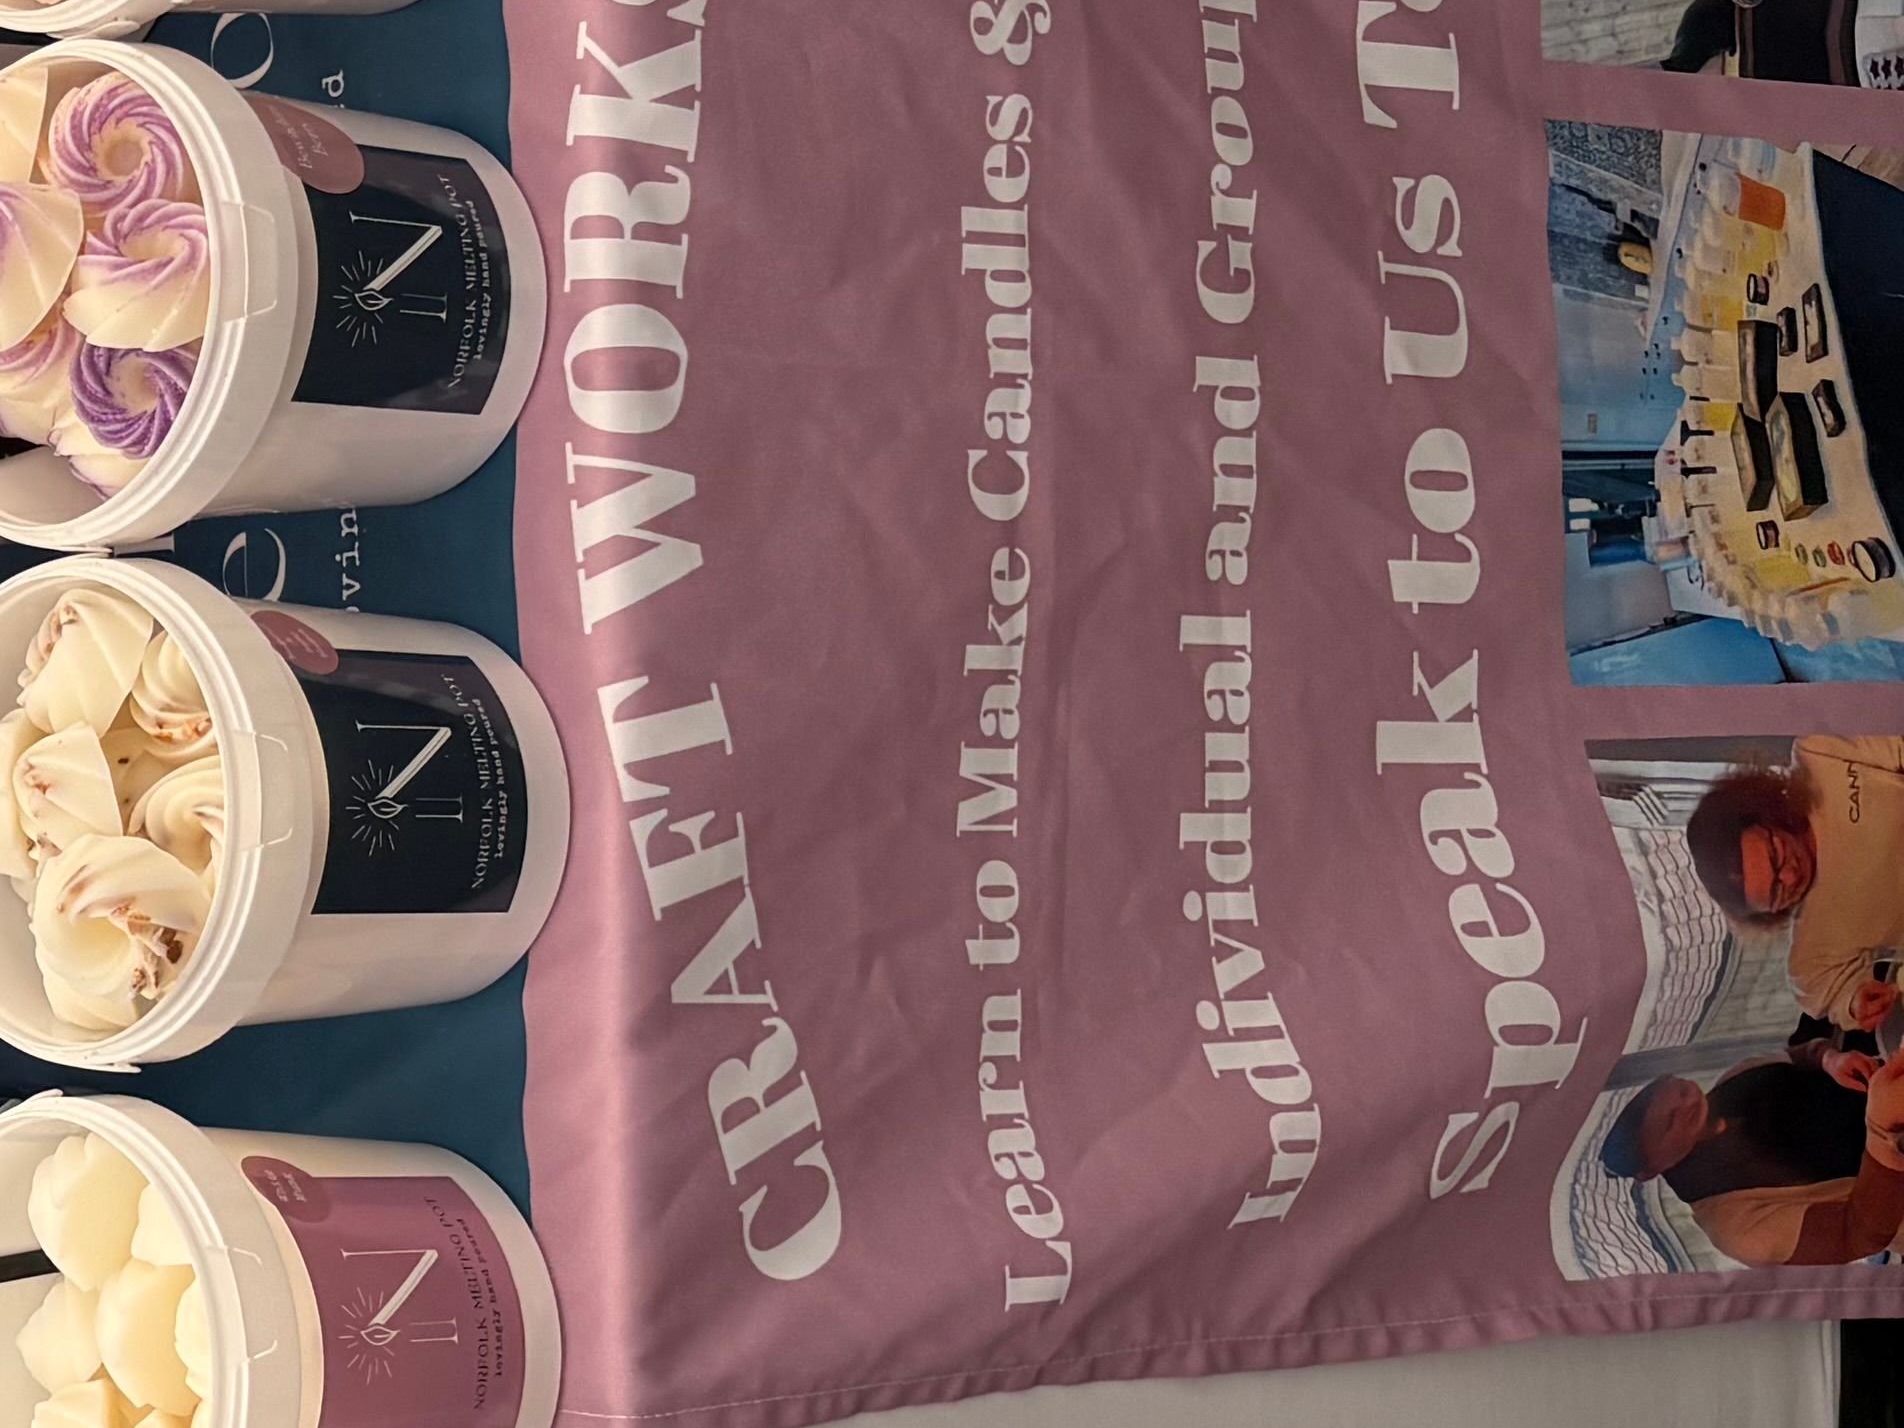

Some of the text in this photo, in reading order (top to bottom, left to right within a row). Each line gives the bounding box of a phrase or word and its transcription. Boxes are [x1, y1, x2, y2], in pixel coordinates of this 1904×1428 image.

[436, 172, 478, 389] NORFOLK MELTING POT
[960, 93, 1034, 523] Candles
[1377, 173, 1468, 386] Us
[1193, 354, 1261, 585] and
[1384, 426, 1483, 615] to
[439, 672, 493, 890] NORFOLK MELTING POT
[471, 697, 498, 745] poured
[489, 750, 505, 785] hand
[955, 546, 1032, 839] Make
[598, 675, 843, 1282] CRAFT
[958, 860, 1024, 969] to
[1179, 609, 1324, 1230] Individual
[1374, 649, 1588, 1200] Speak
[965, 989, 1074, 1311] Learn
[424, 1194, 490, 1410] NORFOLK MELTING POT
